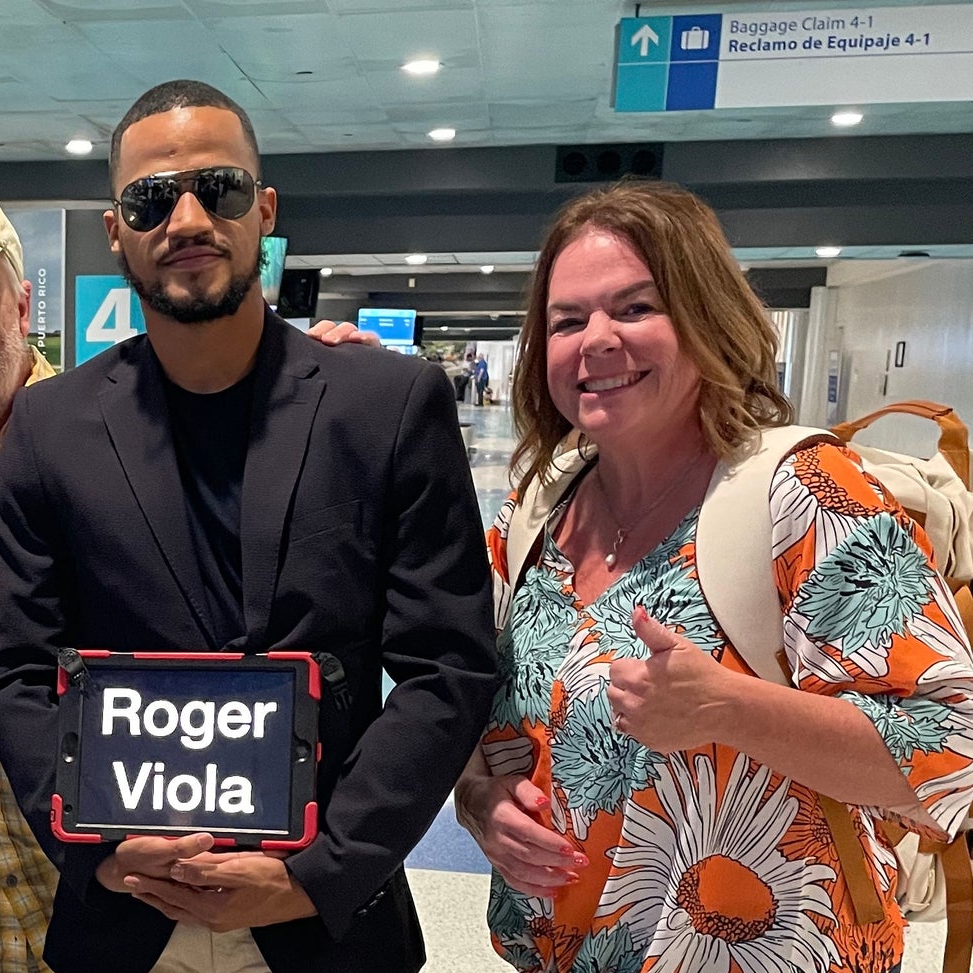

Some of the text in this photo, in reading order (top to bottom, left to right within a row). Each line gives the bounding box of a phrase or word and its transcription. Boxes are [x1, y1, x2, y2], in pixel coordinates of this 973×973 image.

[729, 32, 930, 52] Reclamo de Equipaje 4-1
[730, 15, 873, 36] Baggage Claim 4-1
[37, 268, 47, 348] PUERTO RICO
[85, 287, 138, 345] 4
[101, 687, 278, 750] Roger
[112, 760, 255, 814] Viola
